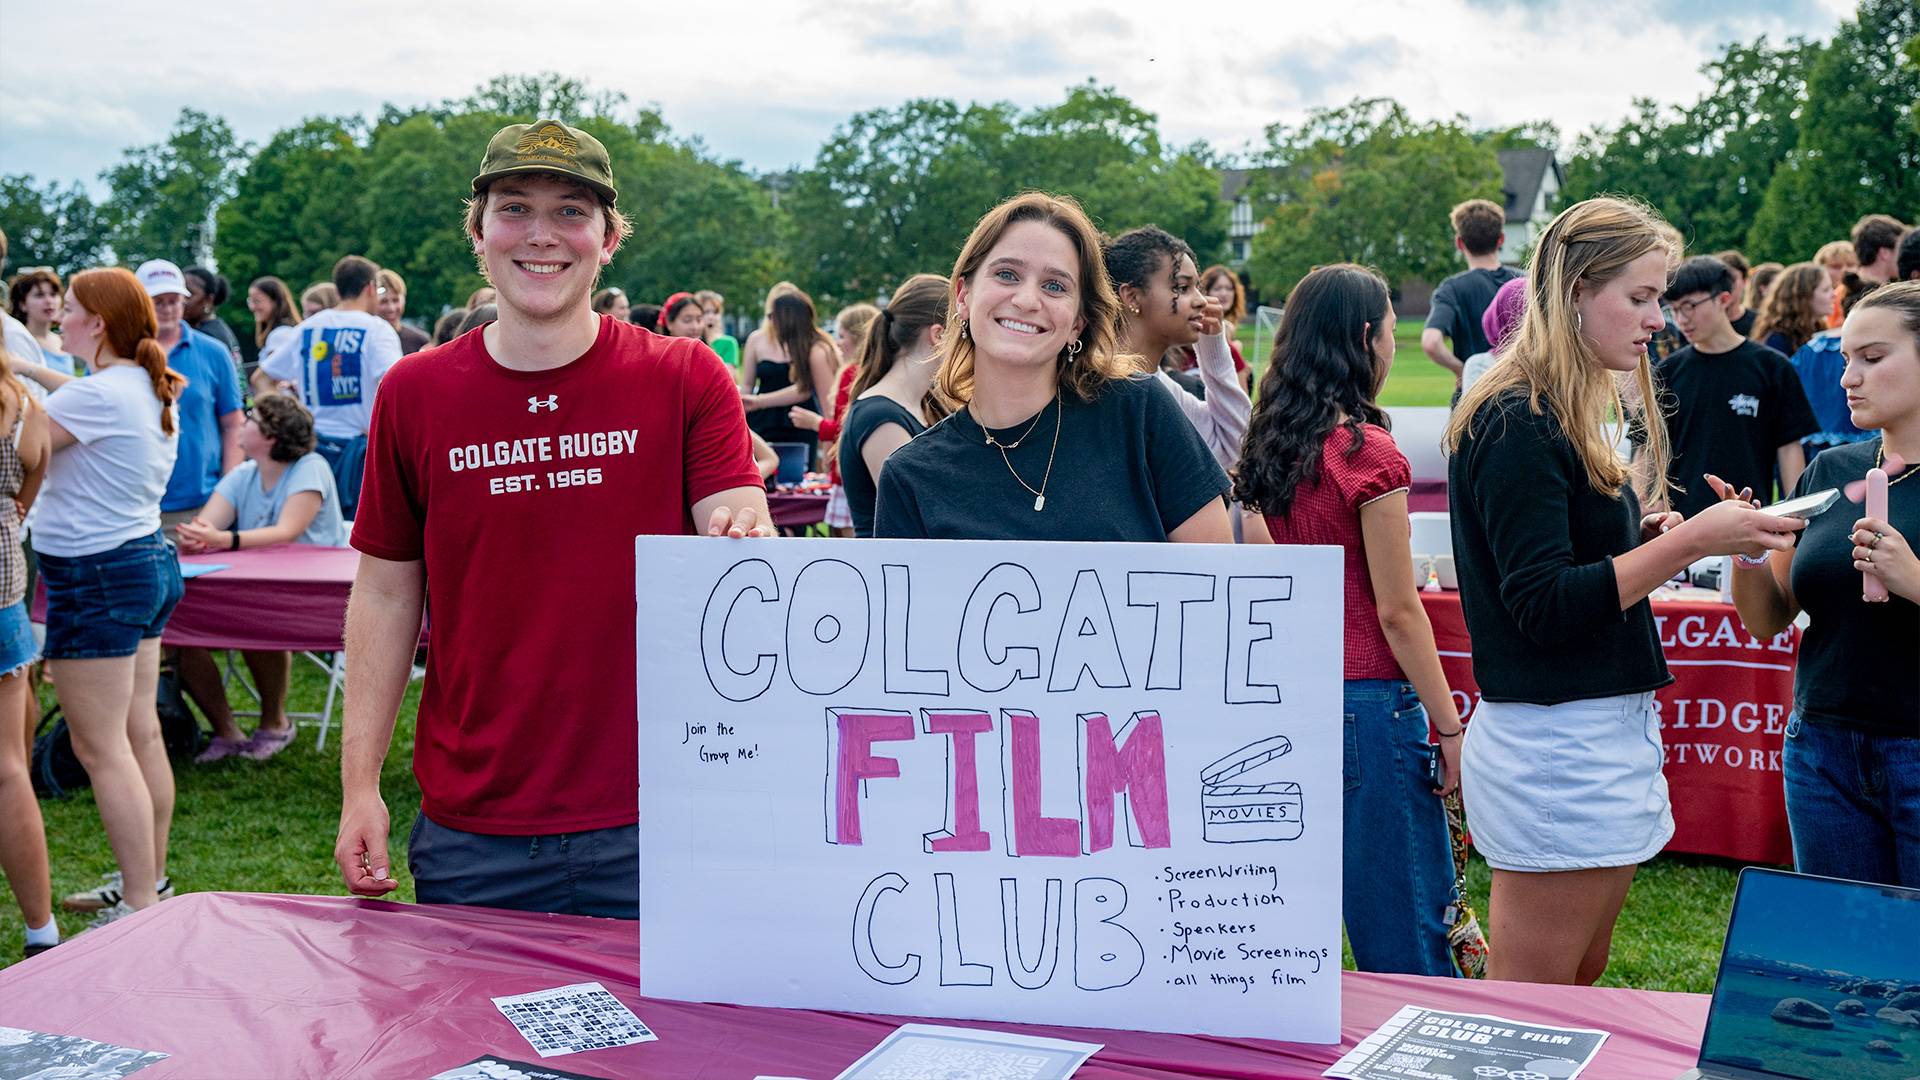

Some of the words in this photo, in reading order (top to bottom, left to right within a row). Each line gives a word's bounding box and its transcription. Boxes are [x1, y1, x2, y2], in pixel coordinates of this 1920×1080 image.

[448, 436, 553, 472] COLGATE
[559, 429, 639, 459] RUGBY
[489, 474, 541, 495] EST.
[547, 467, 603, 489] 1966
[701, 557, 1292, 704] COLGATE
[1654, 615, 1795, 654] LGAE
[682, 721, 707, 745] Join
[717, 721, 735, 736] the
[699, 744, 730, 765] Group
[738, 743, 760, 760] Me!
[825, 706, 1171, 858] FILM
[1209, 805, 1288, 821] MOVIES
[1168, 888, 1285, 913] Production
[852, 871, 1145, 991] CLUB
[1172, 921, 1257, 944] Speakers
[1171, 943, 1227, 965] Movie
[1237, 942, 1329, 974] Screenings
[1174, 974, 1198, 986] all
[1210, 973, 1255, 994] things
[1271, 968, 1307, 986] film
[1417, 1024, 1493, 1045] CLUB
[1423, 1016, 1517, 1038] COLGATE
[1520, 1032, 1573, 1046] FILM
